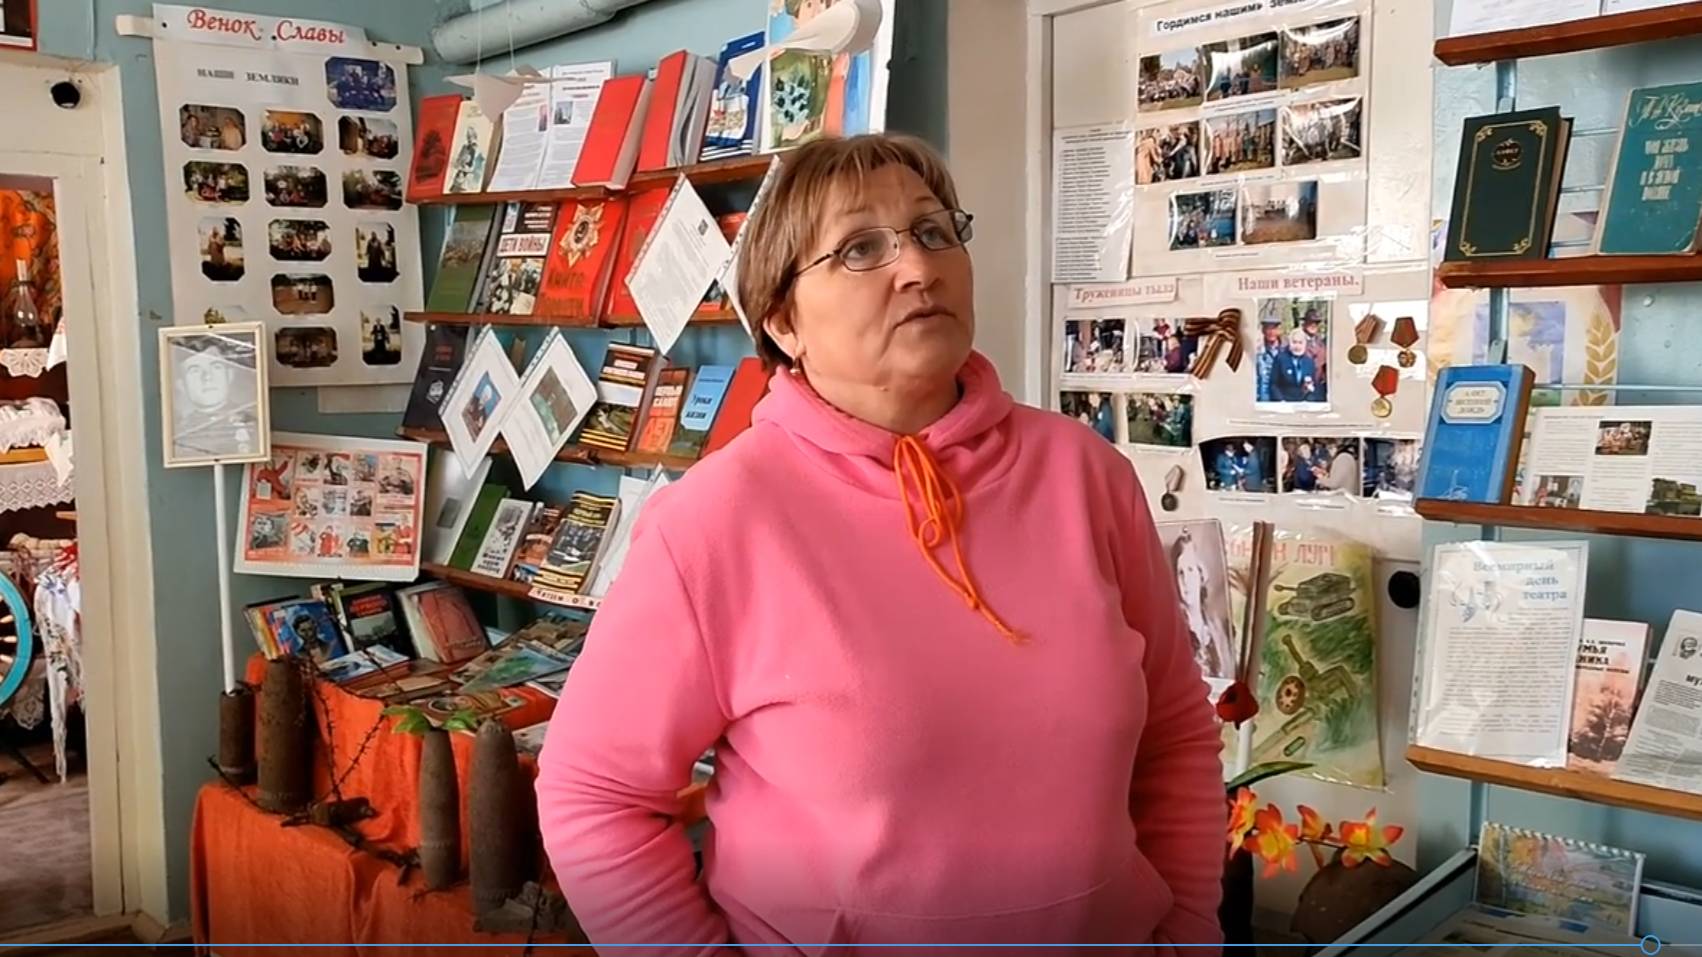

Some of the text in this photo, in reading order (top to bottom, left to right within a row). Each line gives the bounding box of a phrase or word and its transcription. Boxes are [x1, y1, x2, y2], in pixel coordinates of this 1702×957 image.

[187, 9, 345, 43] Венок Славы
[1156, 13, 1212, 31] Гордимся
[197, 68, 299, 86] НАШИ ЗЕМЛЯКИ
[1238, 274, 1360, 291] Наши ветераны.
[1525, 576, 1559, 587] день
[1522, 591, 1568, 602] театра
